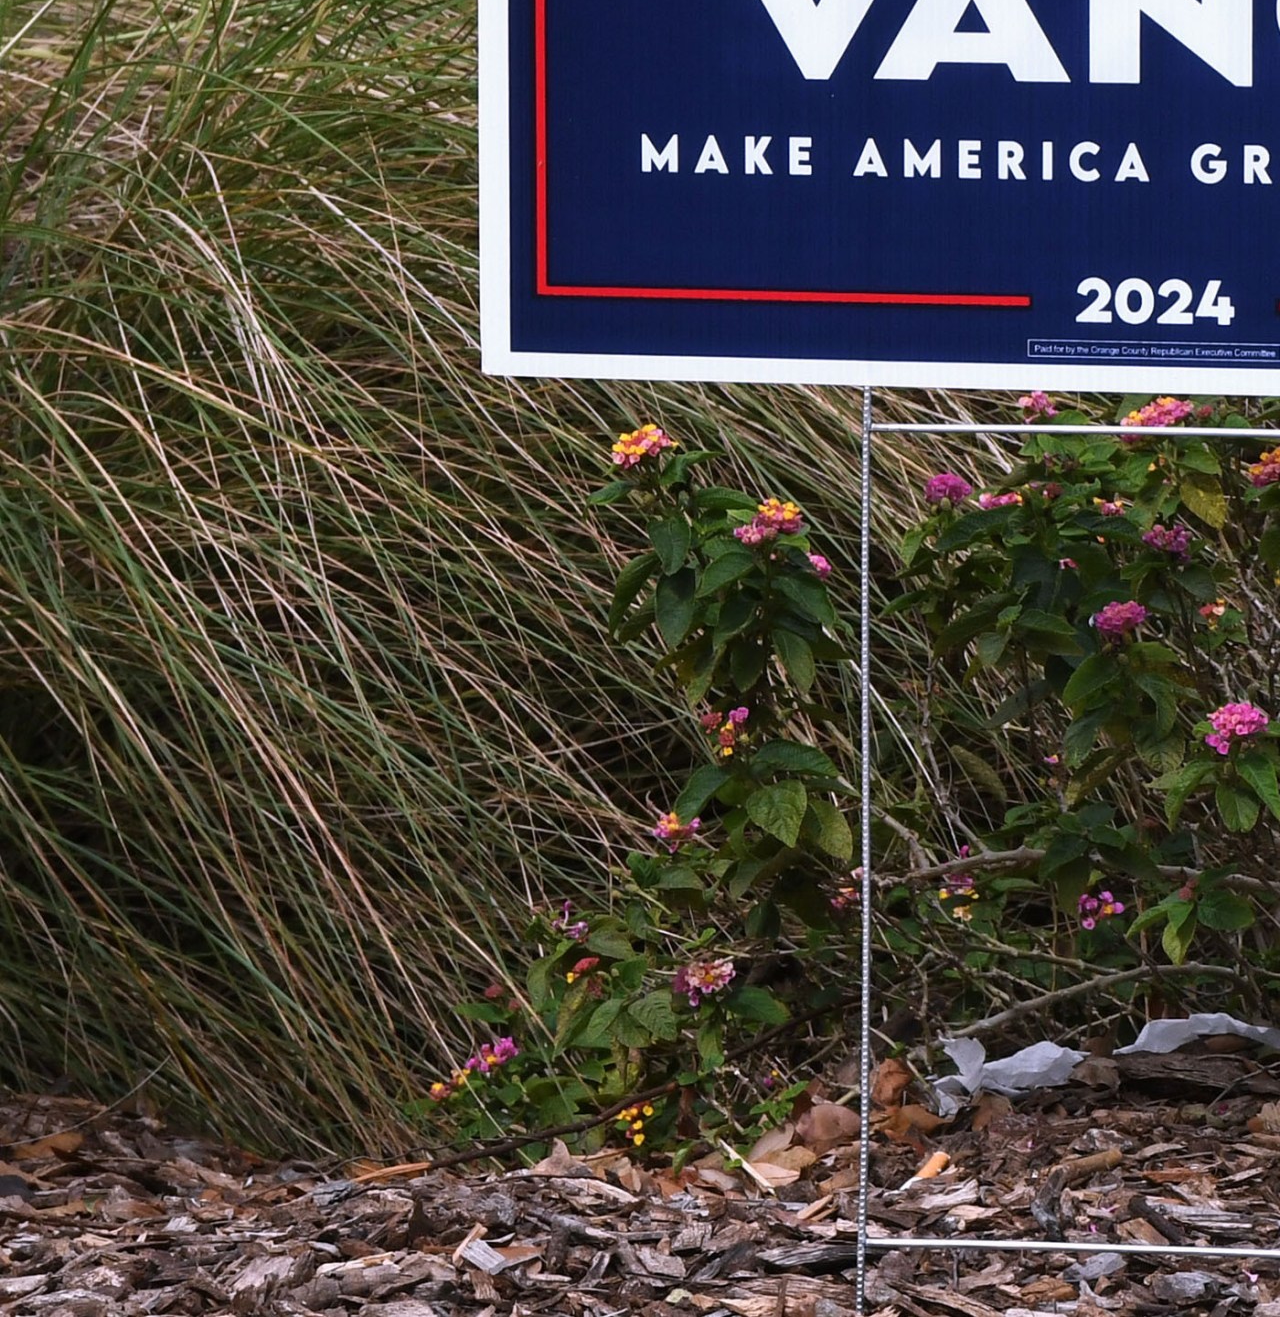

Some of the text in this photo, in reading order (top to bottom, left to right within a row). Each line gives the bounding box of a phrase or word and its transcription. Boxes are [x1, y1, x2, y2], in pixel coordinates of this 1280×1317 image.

[642, 134, 812, 175] MAKE
[853, 138, 1149, 182] AMERICA
[1076, 278, 1234, 325] 2024
[1034, 344, 1276, 358] Paid for by the Orange County Republican Executive Committee
